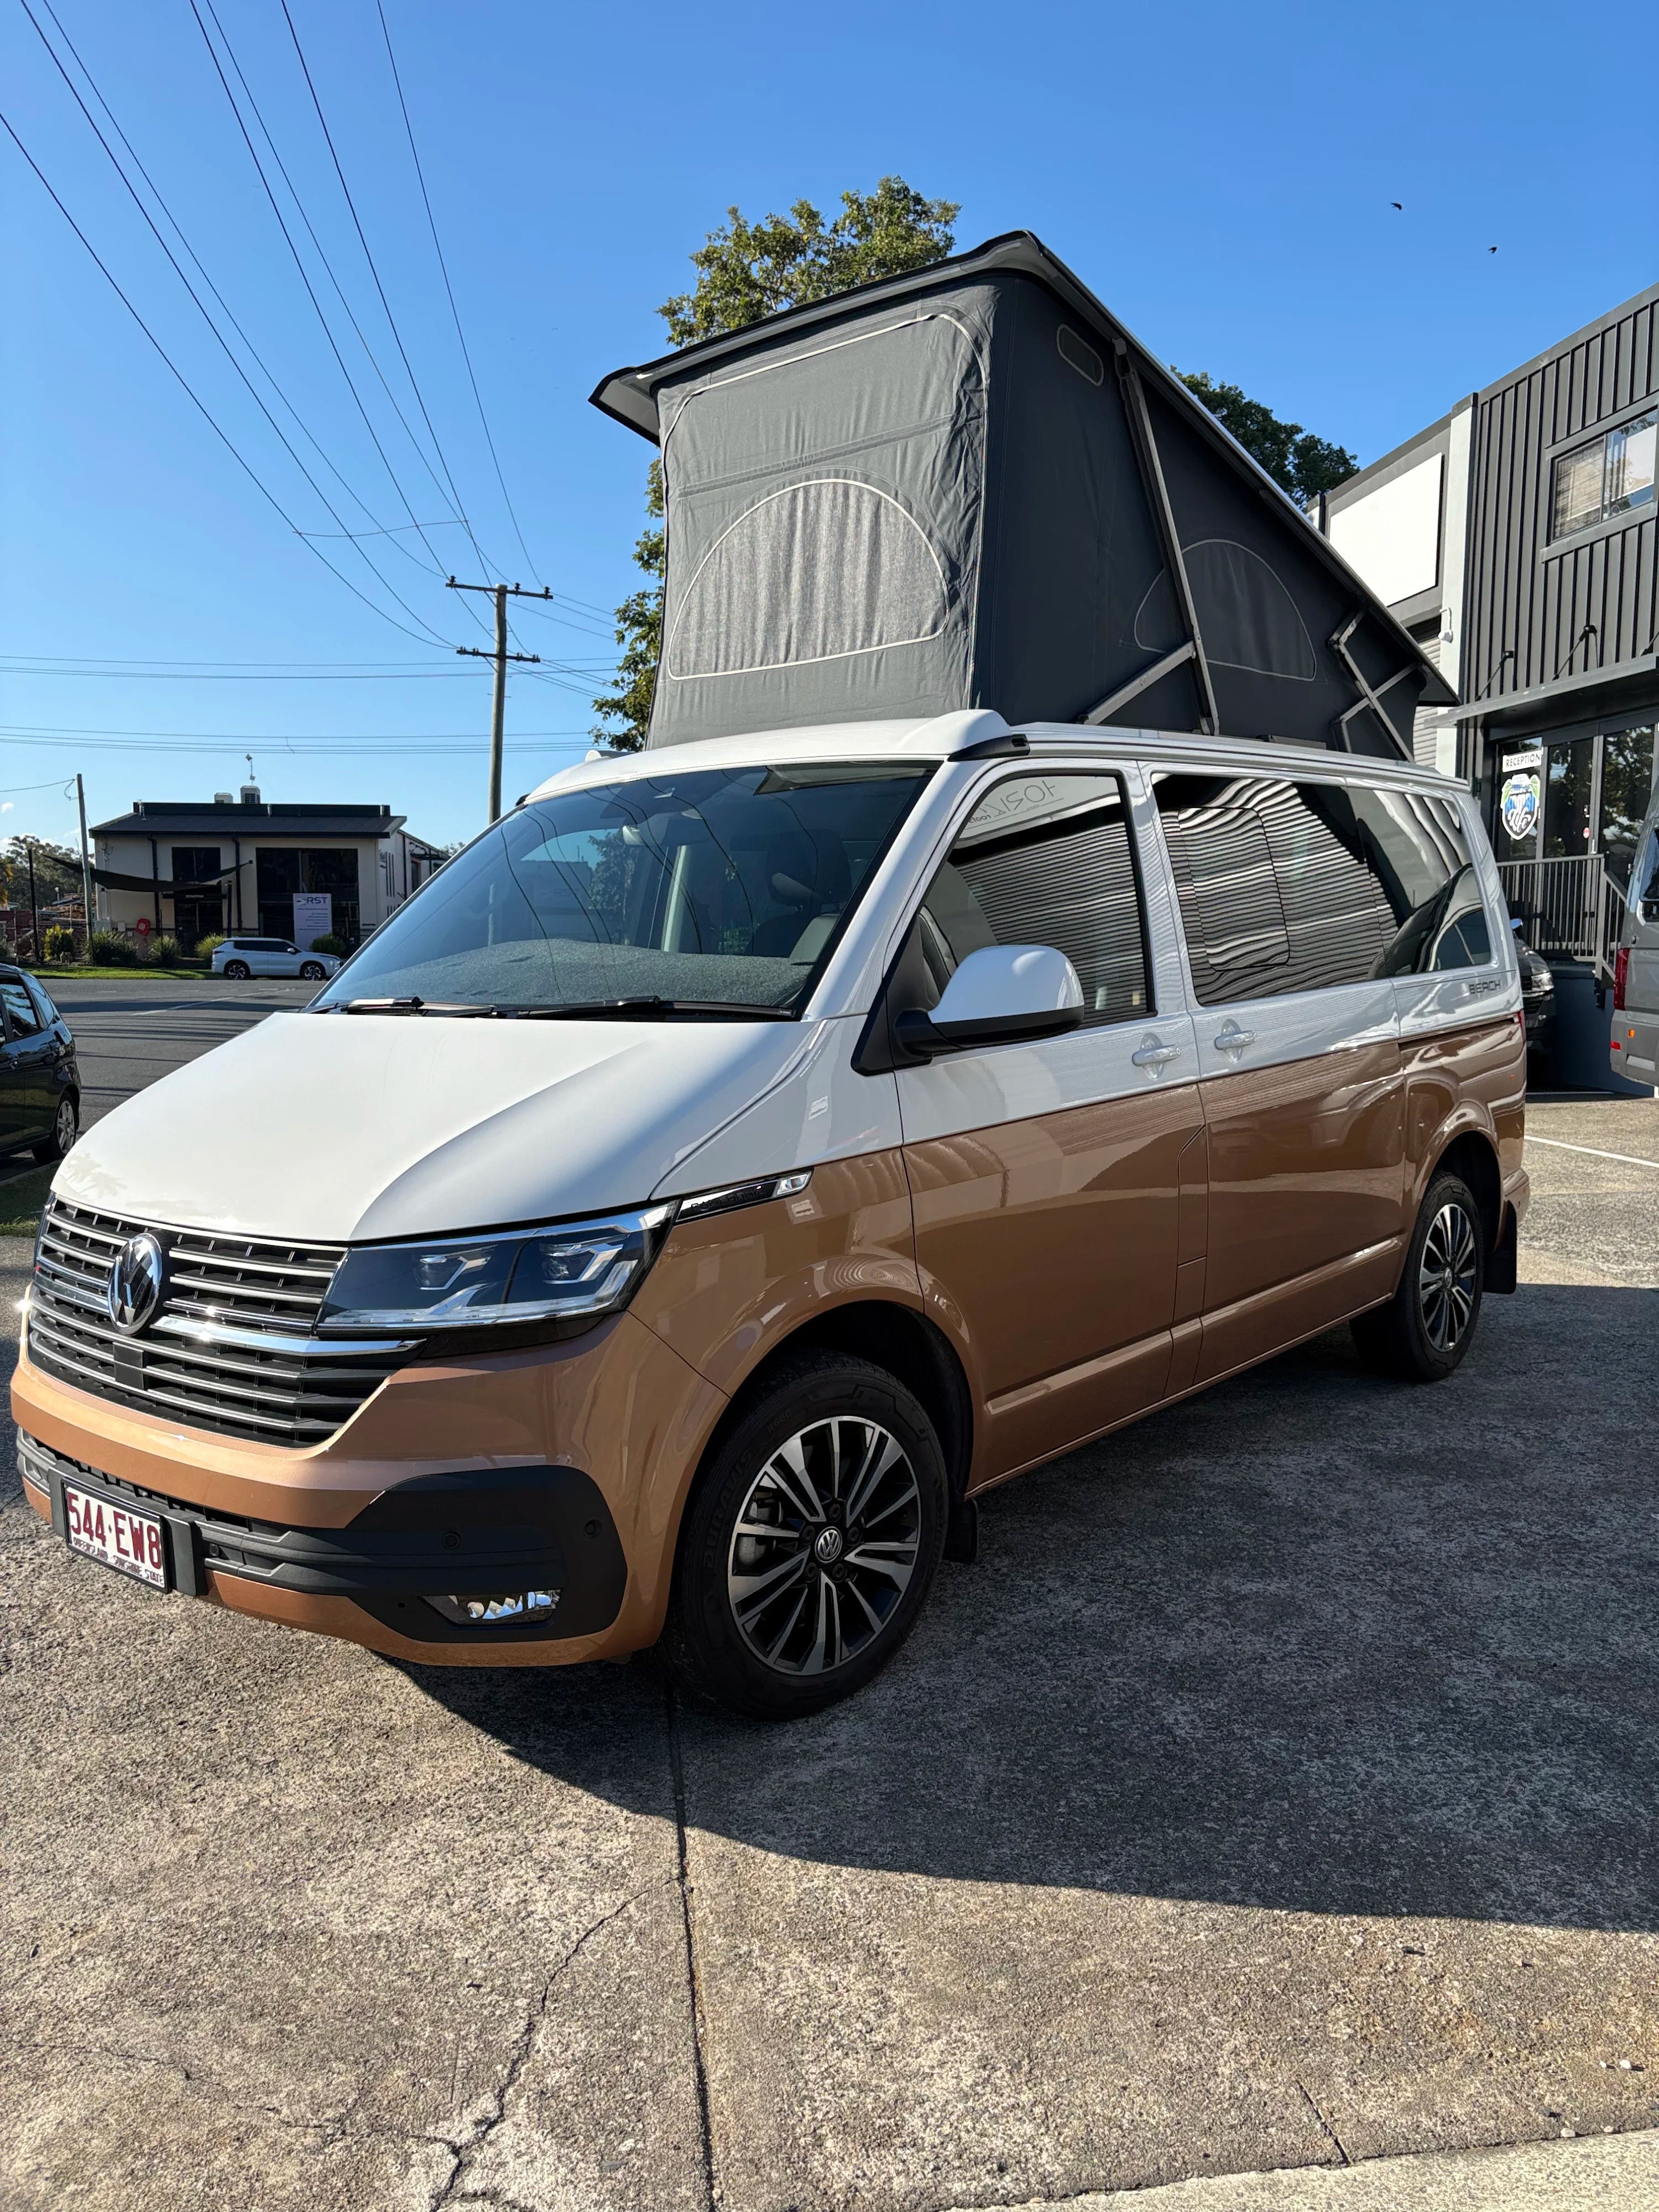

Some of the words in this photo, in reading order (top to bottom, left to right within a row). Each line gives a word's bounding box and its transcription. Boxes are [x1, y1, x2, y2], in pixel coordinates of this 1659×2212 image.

[1506, 753, 1540, 768] RECEPTION
[1469, 979, 1501, 994] BEACH
[703, 1448, 752, 1569] DURAVIS
